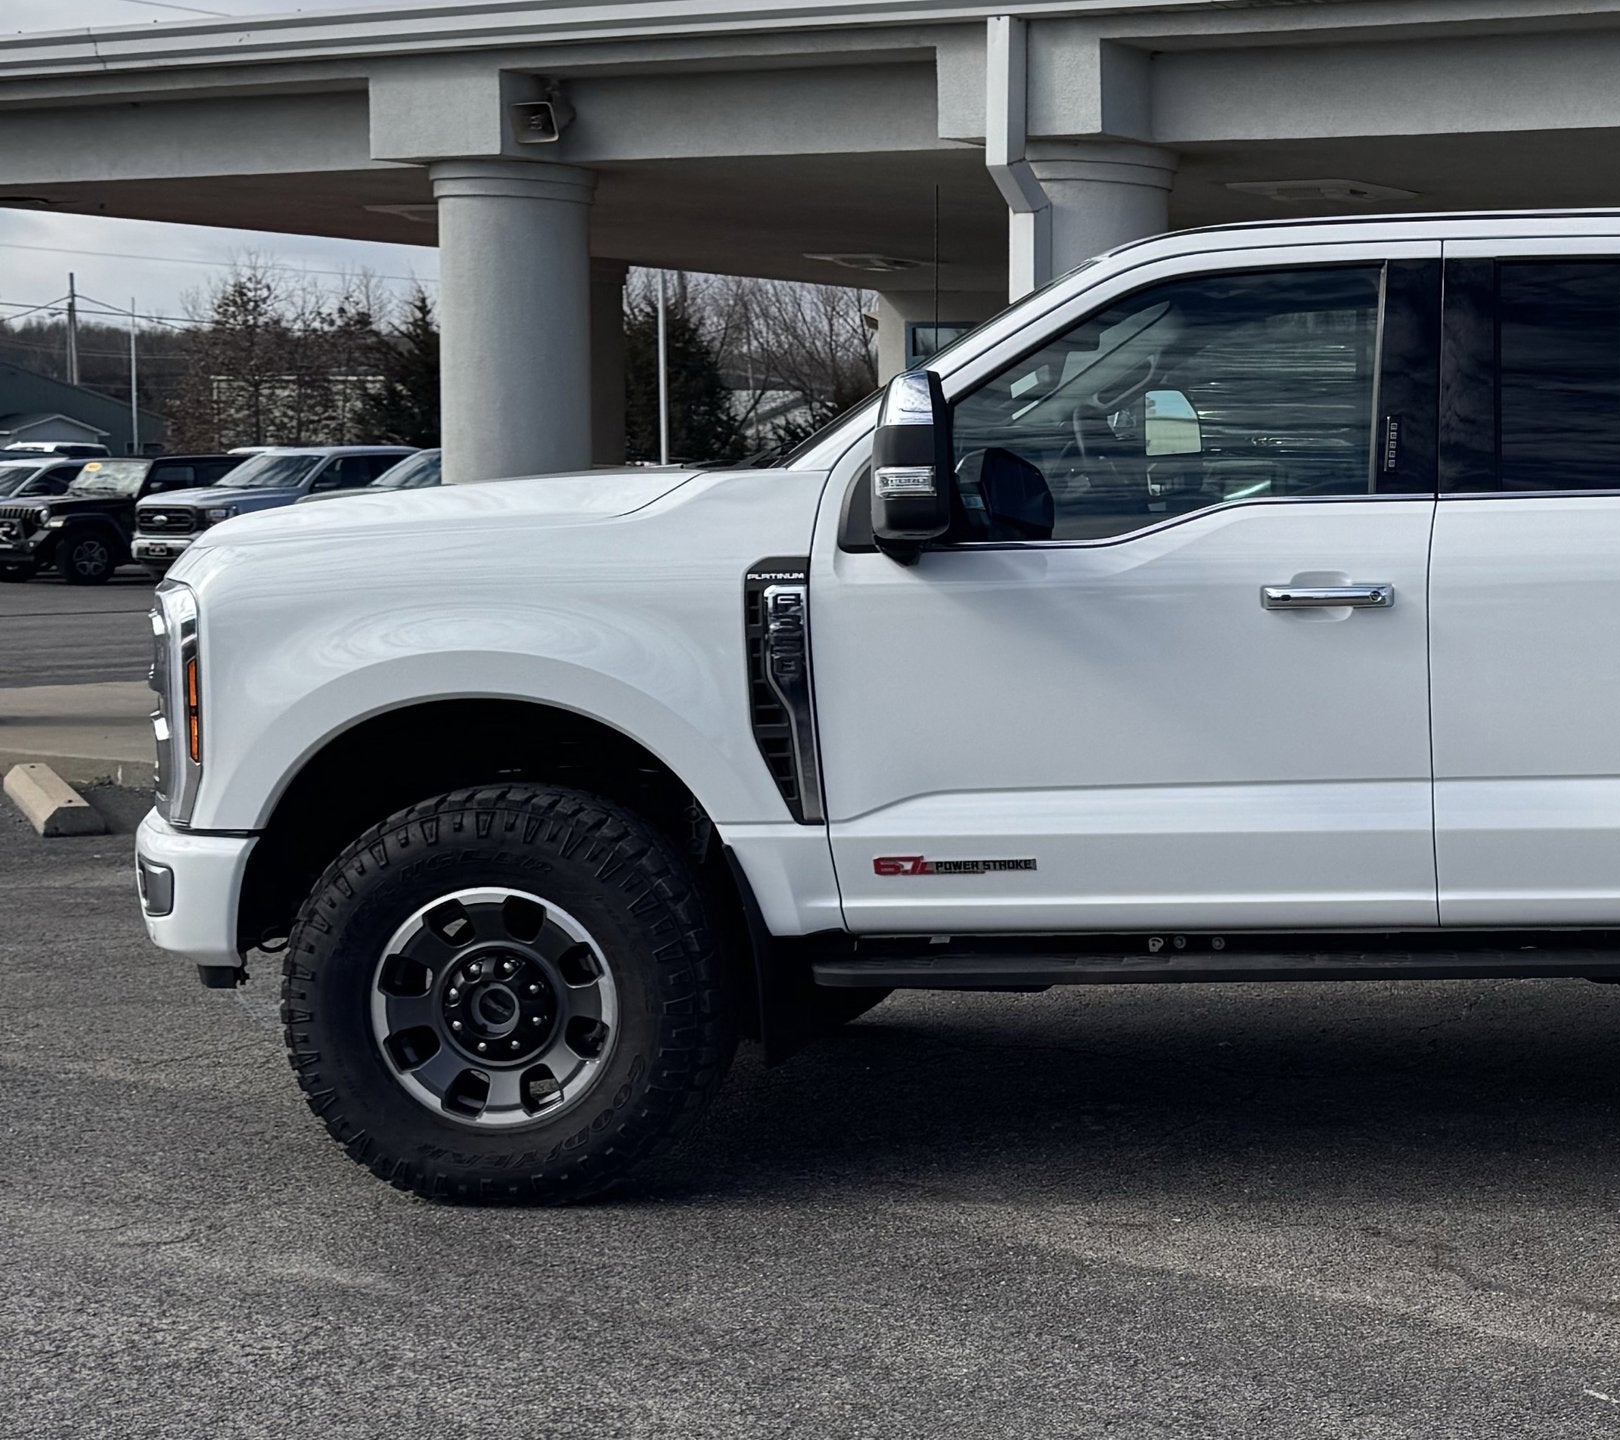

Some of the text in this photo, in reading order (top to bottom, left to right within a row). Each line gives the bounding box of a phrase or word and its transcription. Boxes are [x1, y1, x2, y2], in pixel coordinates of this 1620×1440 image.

[747, 572, 805, 580] PLATINUM
[935, 860, 979, 871] POWER
[982, 859, 1033, 871] STROKE
